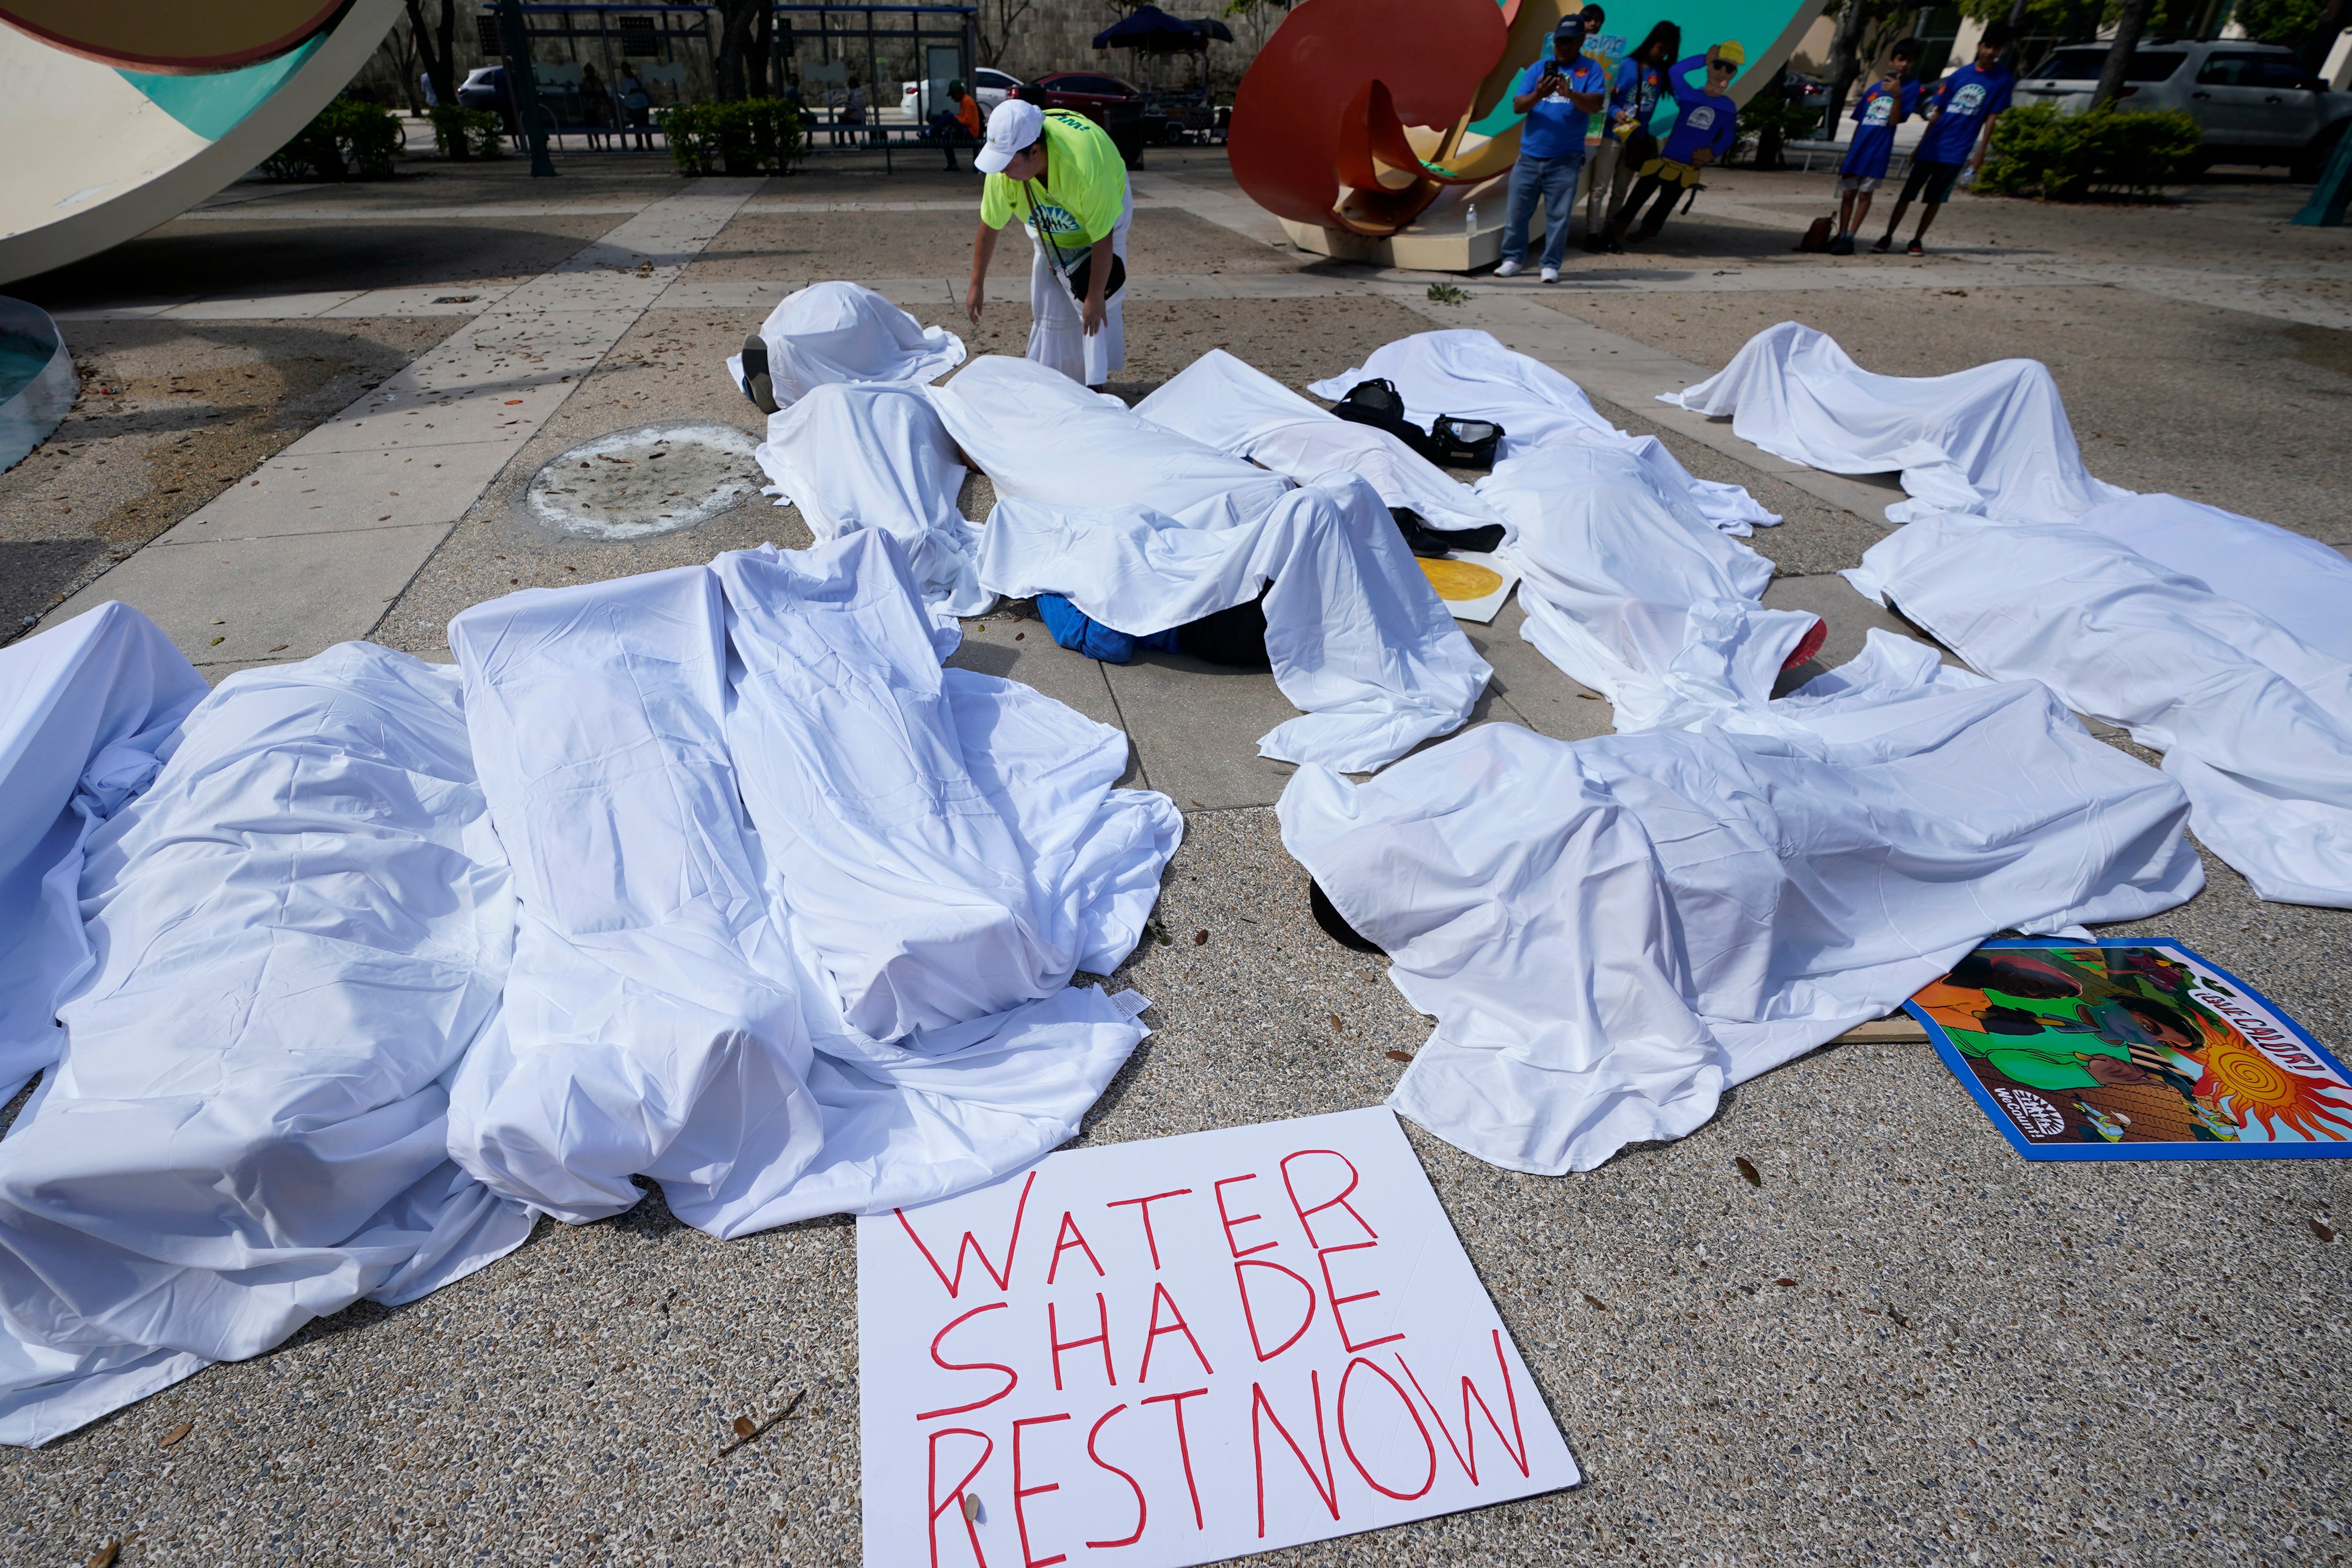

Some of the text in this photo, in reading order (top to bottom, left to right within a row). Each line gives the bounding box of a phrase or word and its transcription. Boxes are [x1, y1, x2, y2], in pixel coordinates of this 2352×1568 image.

[2233, 1018, 2326, 1071] CALOR!
[895, 1150, 1379, 1299] WATER
[917, 1241, 1406, 1421] SHADE
[928, 1329, 1530, 1568] REST NOW
